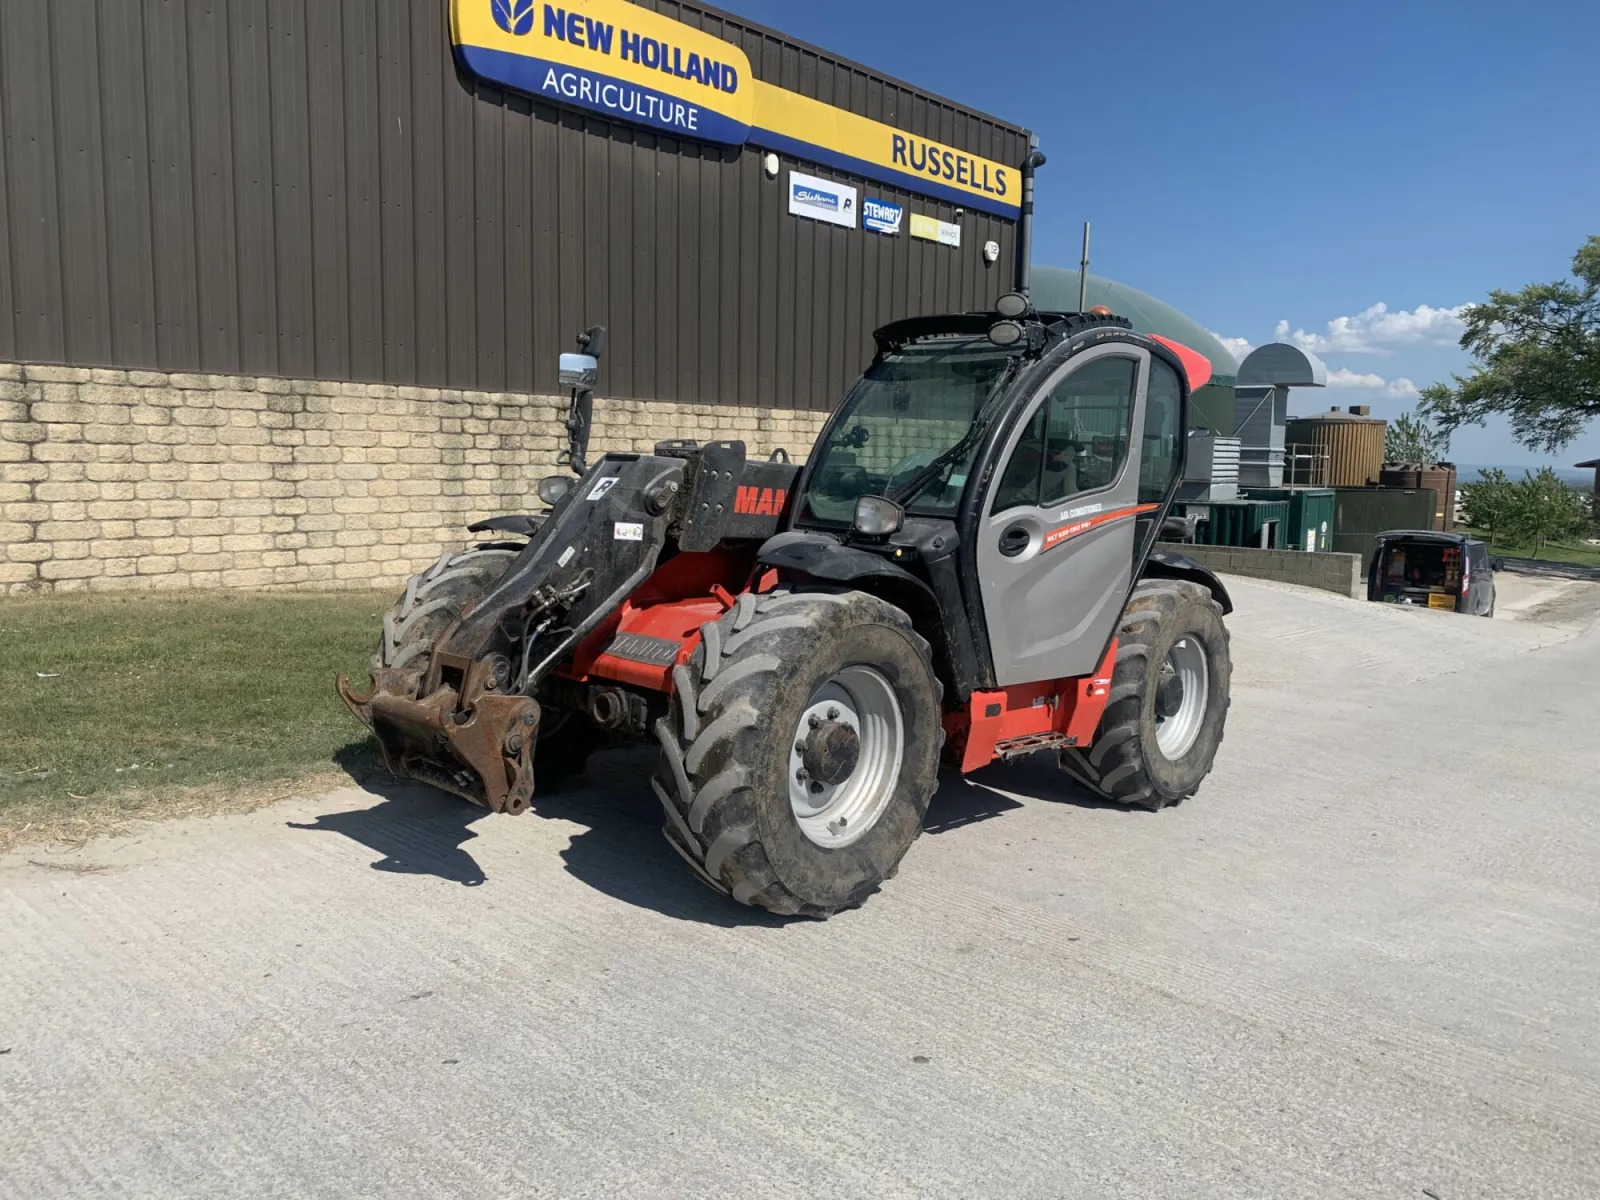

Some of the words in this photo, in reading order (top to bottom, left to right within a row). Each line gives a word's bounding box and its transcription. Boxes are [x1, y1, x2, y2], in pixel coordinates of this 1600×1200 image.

[543, 4, 613, 54] NEW
[620, 29, 738, 94] HOLLAND
[541, 68, 698, 130] AGRICULTURE
[892, 133, 1007, 196] RUSSELLS
[863, 202, 899, 222] STEWART
